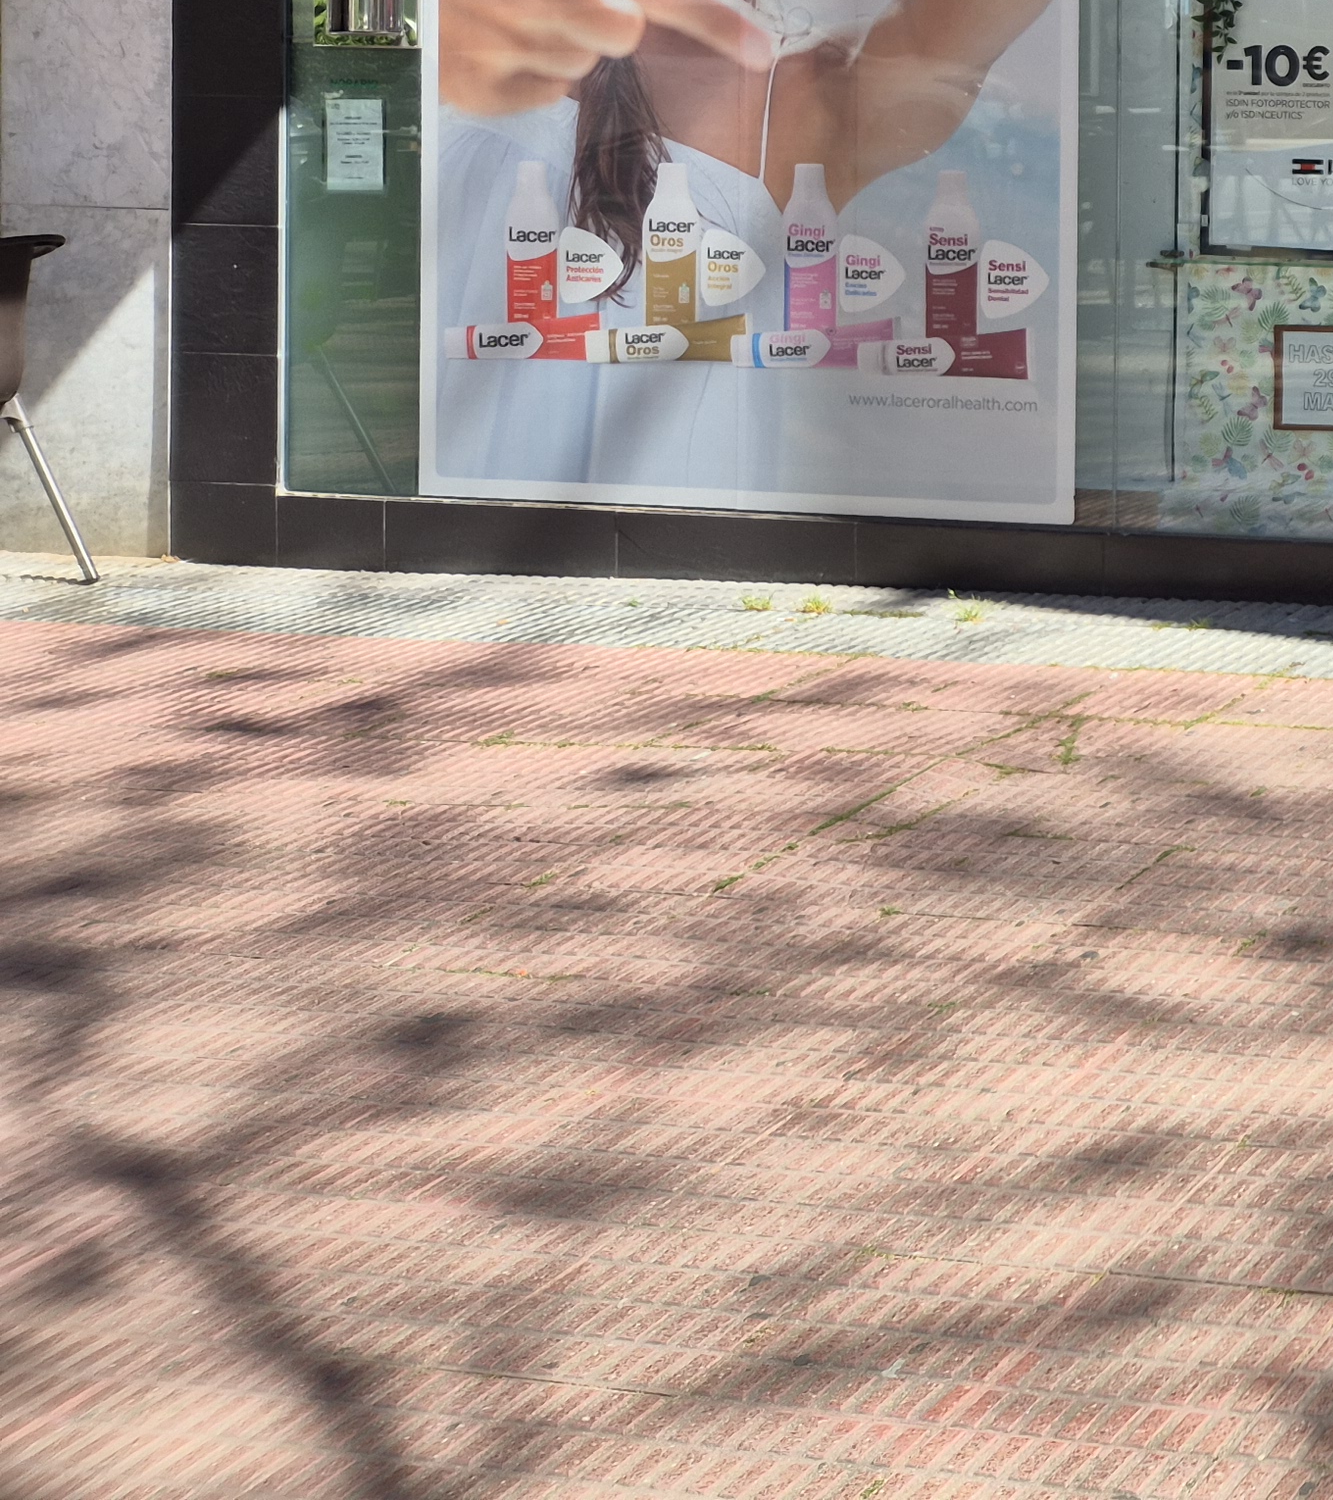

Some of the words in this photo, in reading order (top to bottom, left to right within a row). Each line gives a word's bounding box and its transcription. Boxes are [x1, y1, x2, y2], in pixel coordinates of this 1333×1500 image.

[1251, 99, 1331, 109] FOTOPROTECTOR
[1291, 177, 1317, 186] LOVE
[648, 218, 695, 234] Lacer
[788, 223, 826, 240] Gingi
[508, 226, 556, 243] Lacer
[650, 234, 684, 248] Oros
[929, 233, 968, 246] Sensi
[786, 236, 834, 253] Lacer
[566, 250, 604, 263] Lacer
[707, 247, 745, 260] Lacer
[927, 245, 975, 262] Lacer
[708, 261, 739, 273] Oros
[845, 254, 881, 268] Gingi
[988, 260, 1027, 272] Sensi
[566, 265, 604, 274] Protección
[845, 266, 885, 280] Lacer
[987, 272, 1027, 286] Lacer
[478, 332, 529, 348] Lacer
[625, 332, 665, 345] Lacer
[769, 334, 806, 345] Gingi
[626, 345, 660, 356] Oros
[769, 344, 810, 357] Lacer
[896, 344, 932, 355] Sensi
[896, 355, 936, 368] Lacer
[849, 391, 1038, 412] www.laceroralhealth.com
